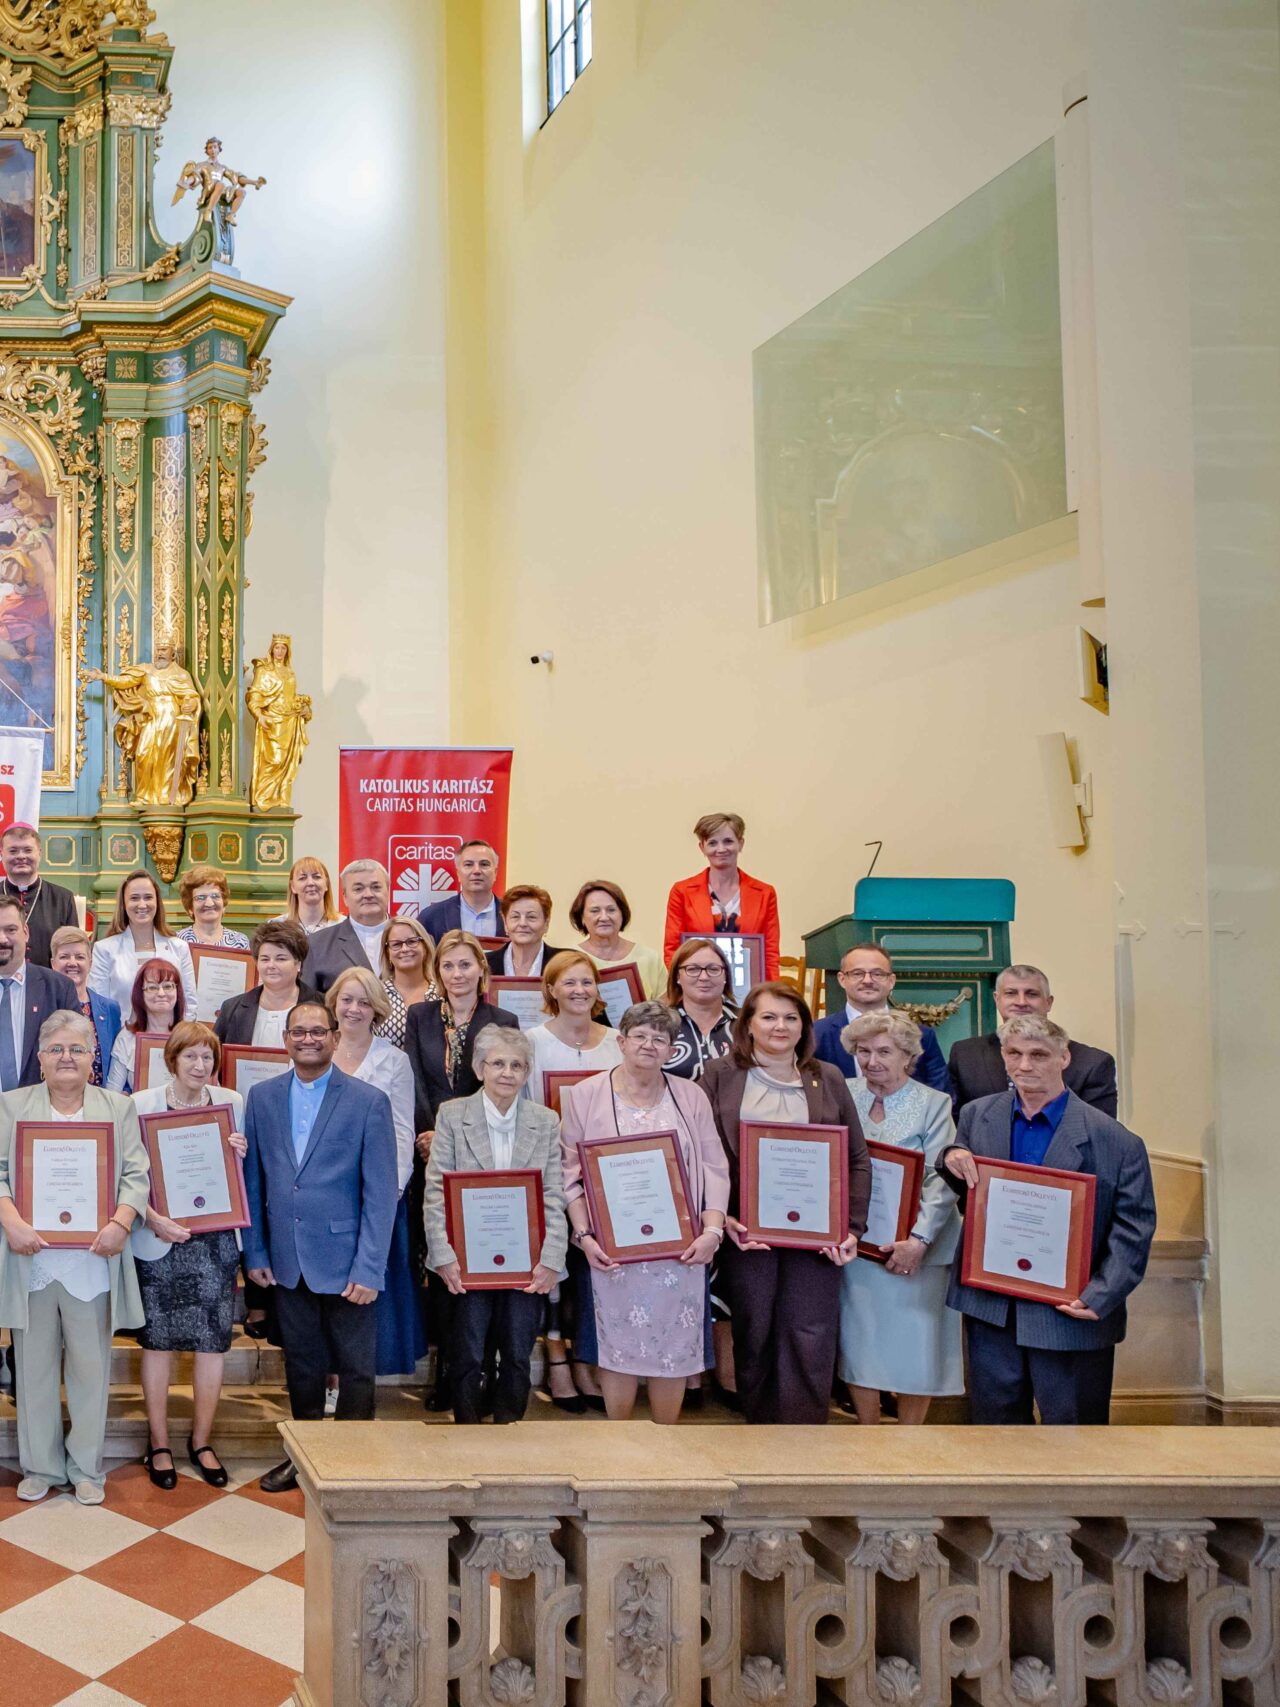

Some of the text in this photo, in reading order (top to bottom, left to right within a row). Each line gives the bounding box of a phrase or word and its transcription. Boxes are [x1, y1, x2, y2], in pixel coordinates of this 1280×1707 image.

[360, 777, 494, 794] KATOLIKUS KARITÁSZ
[366, 797, 486, 813] CARITAS HUNGARICA
[395, 842, 455, 860] caritas
